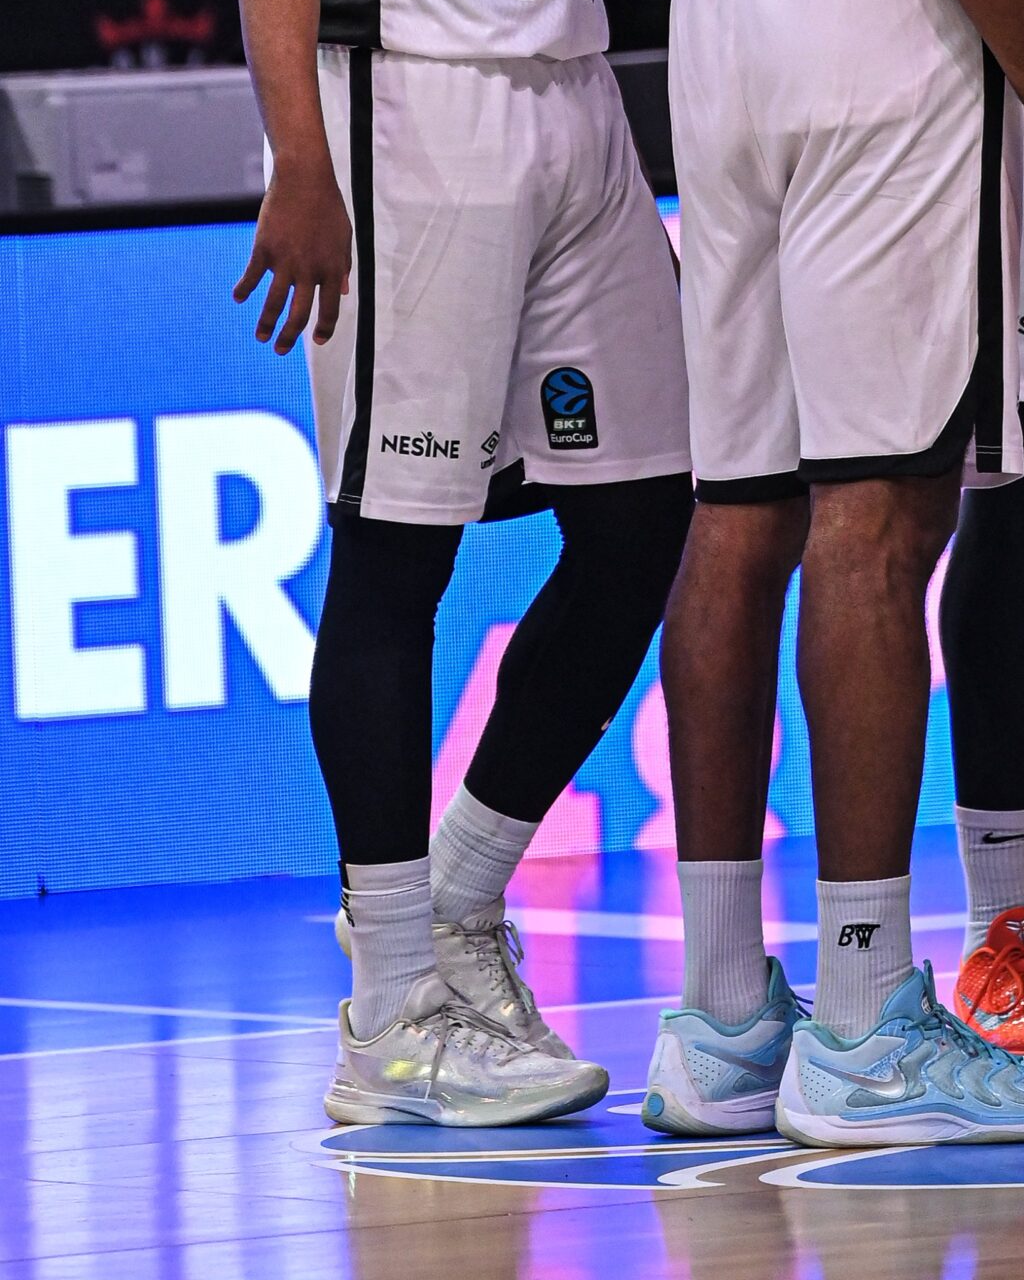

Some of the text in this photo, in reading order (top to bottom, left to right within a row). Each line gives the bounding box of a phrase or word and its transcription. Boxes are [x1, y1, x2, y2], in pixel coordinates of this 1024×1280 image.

[553, 419, 586, 430] BKT
[550, 432, 593, 444] EuroCup
[5, 408, 325, 721] ER
